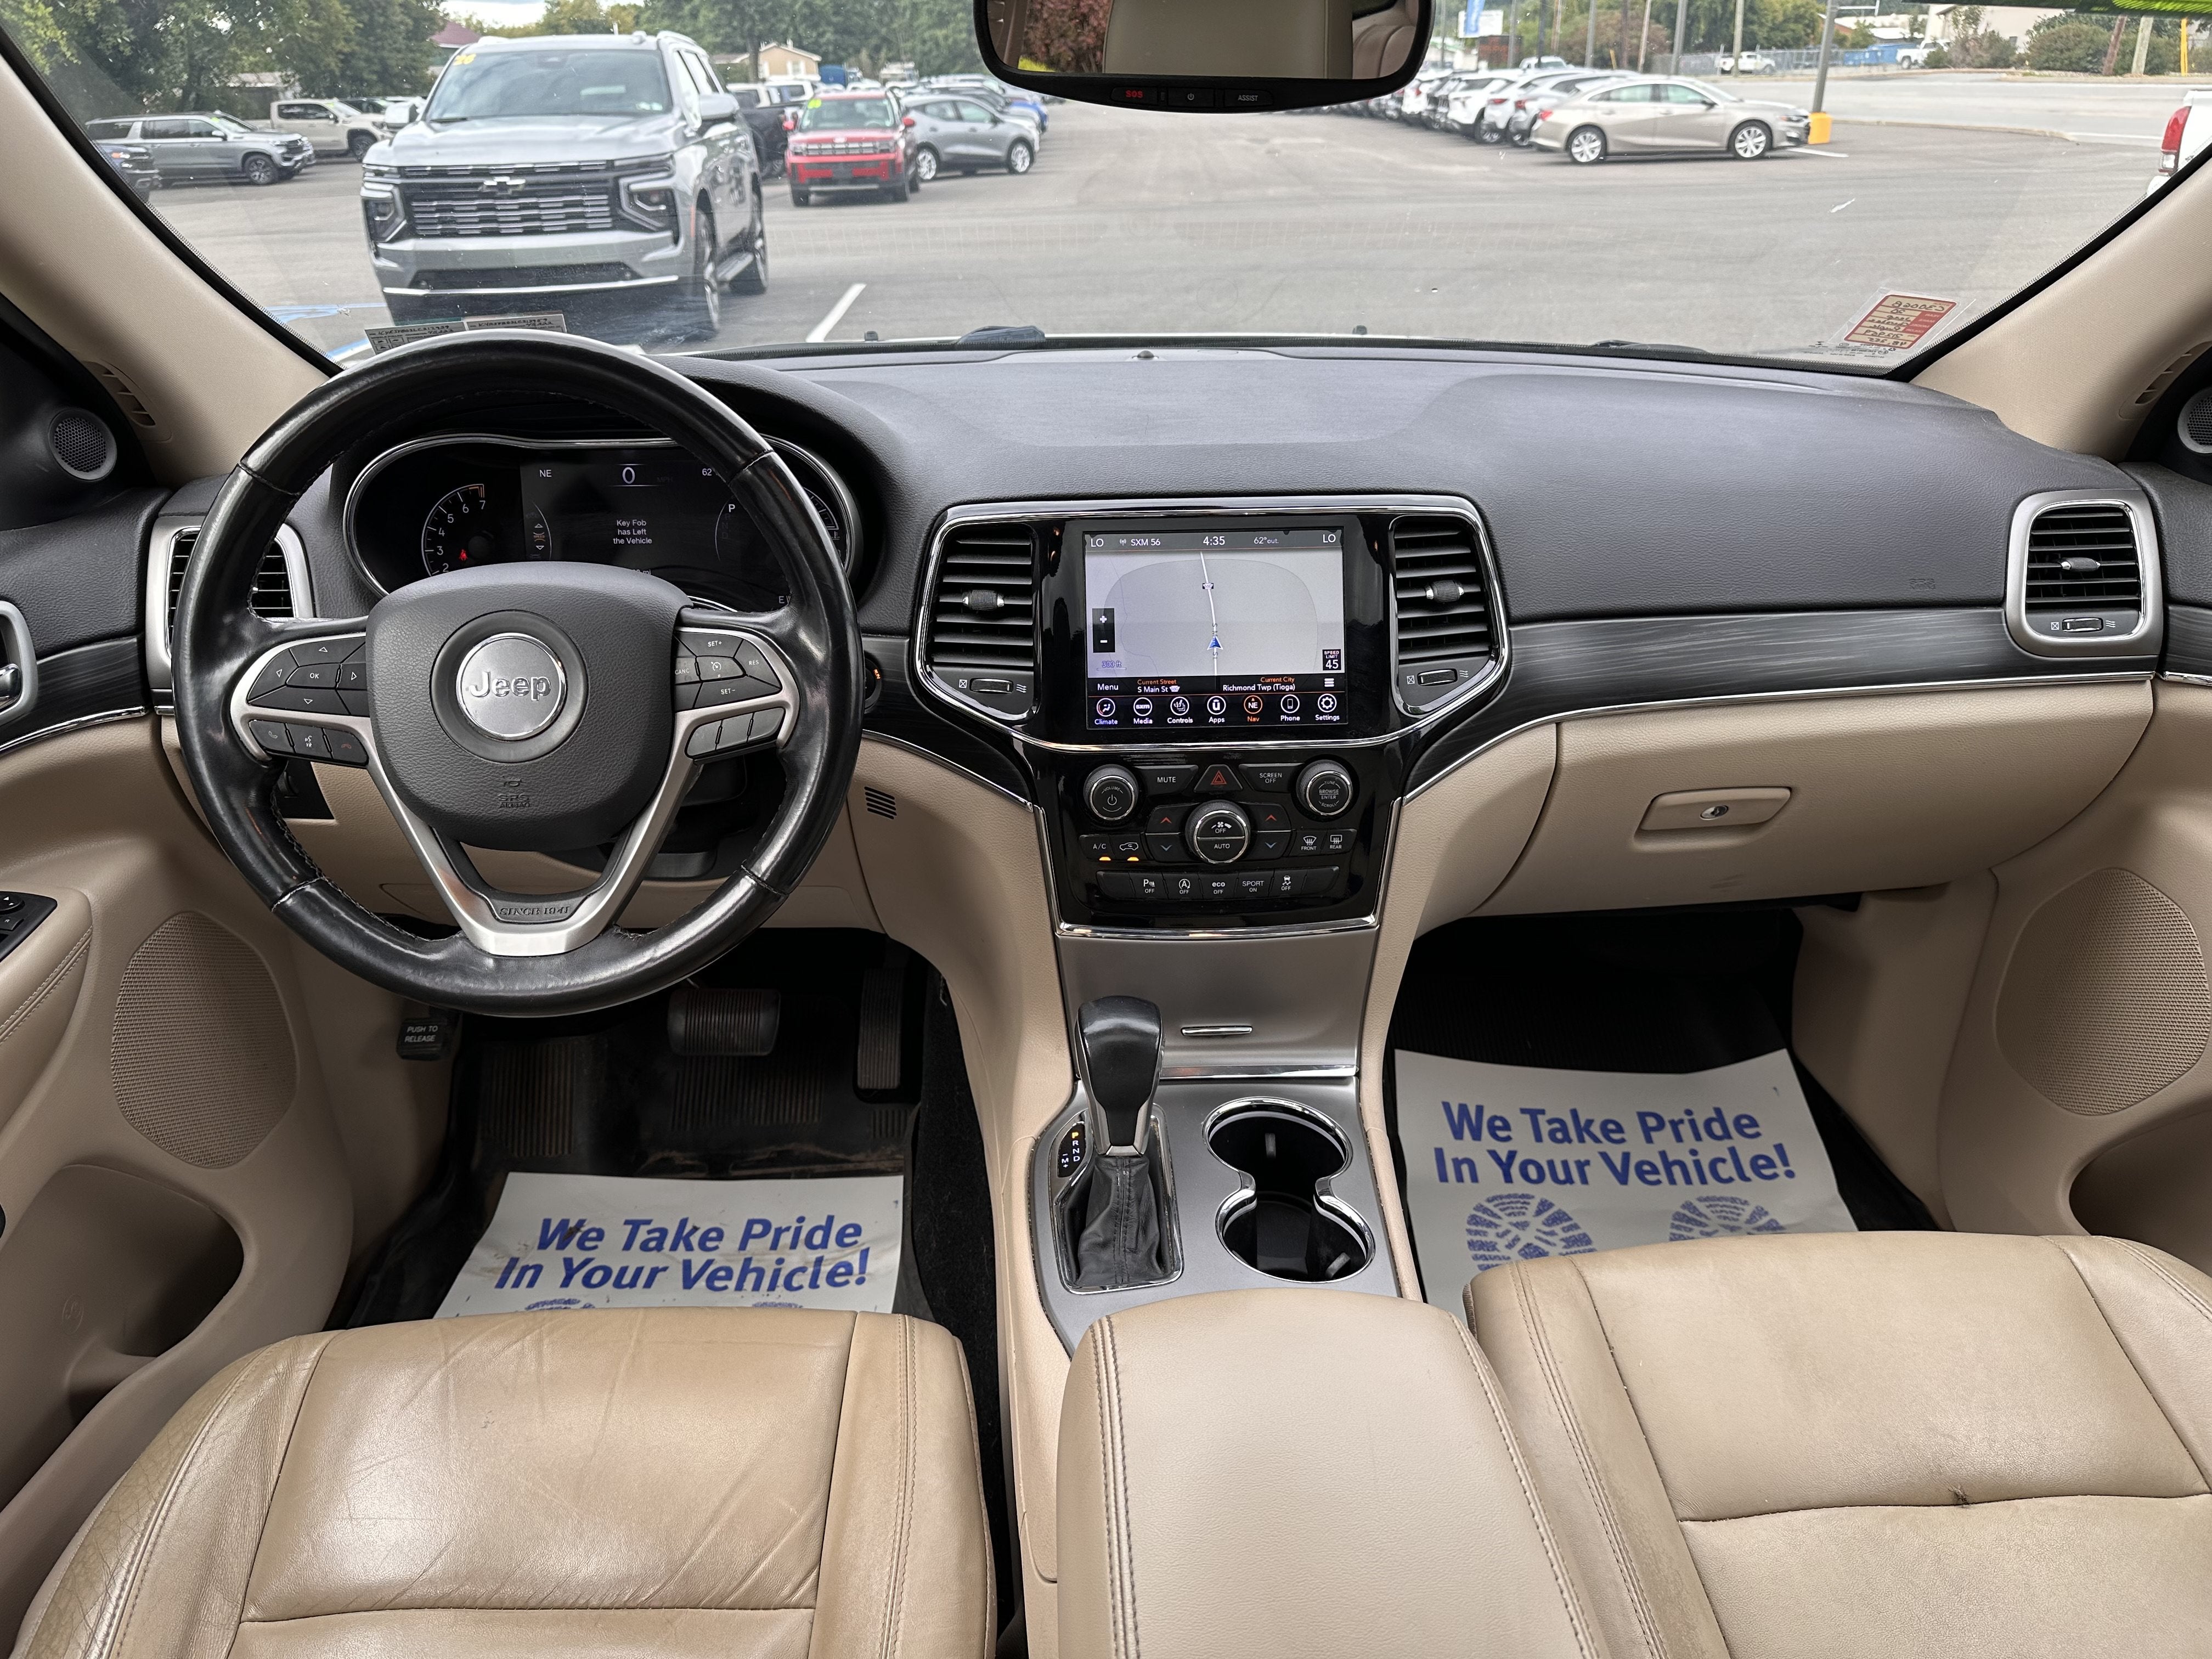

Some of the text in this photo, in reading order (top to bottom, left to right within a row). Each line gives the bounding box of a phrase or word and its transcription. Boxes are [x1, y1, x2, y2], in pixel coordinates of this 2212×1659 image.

[1126, 90, 1143, 98] SOS
[540, 469, 552, 478] NE
[622, 467, 636, 484] 0
[702, 468, 712, 476] 62
[462, 504, 470, 514] 6
[479, 500, 486, 510] 7
[728, 504, 735, 512] P
[447, 514, 454, 523] 5
[438, 527, 445, 537] 4
[1091, 538, 1104, 547] LO
[1203, 535, 1226, 546] 4:35
[1323, 534, 1336, 543] LO
[437, 545, 444, 555] 3
[442, 563, 449, 572] 2
[778, 595, 785, 604] E
[1325, 659, 1339, 669] 45
[469, 671, 551, 701] Jeep
[500, 906, 571, 916] SINCE 1941
[1441, 1101, 1761, 1145] We Take Pride
[1433, 1143, 1797, 1187] In Your Vehicle!
[537, 1214, 864, 1252] We Take Pride
[495, 1247, 870, 1292] In Your Vehicle!
